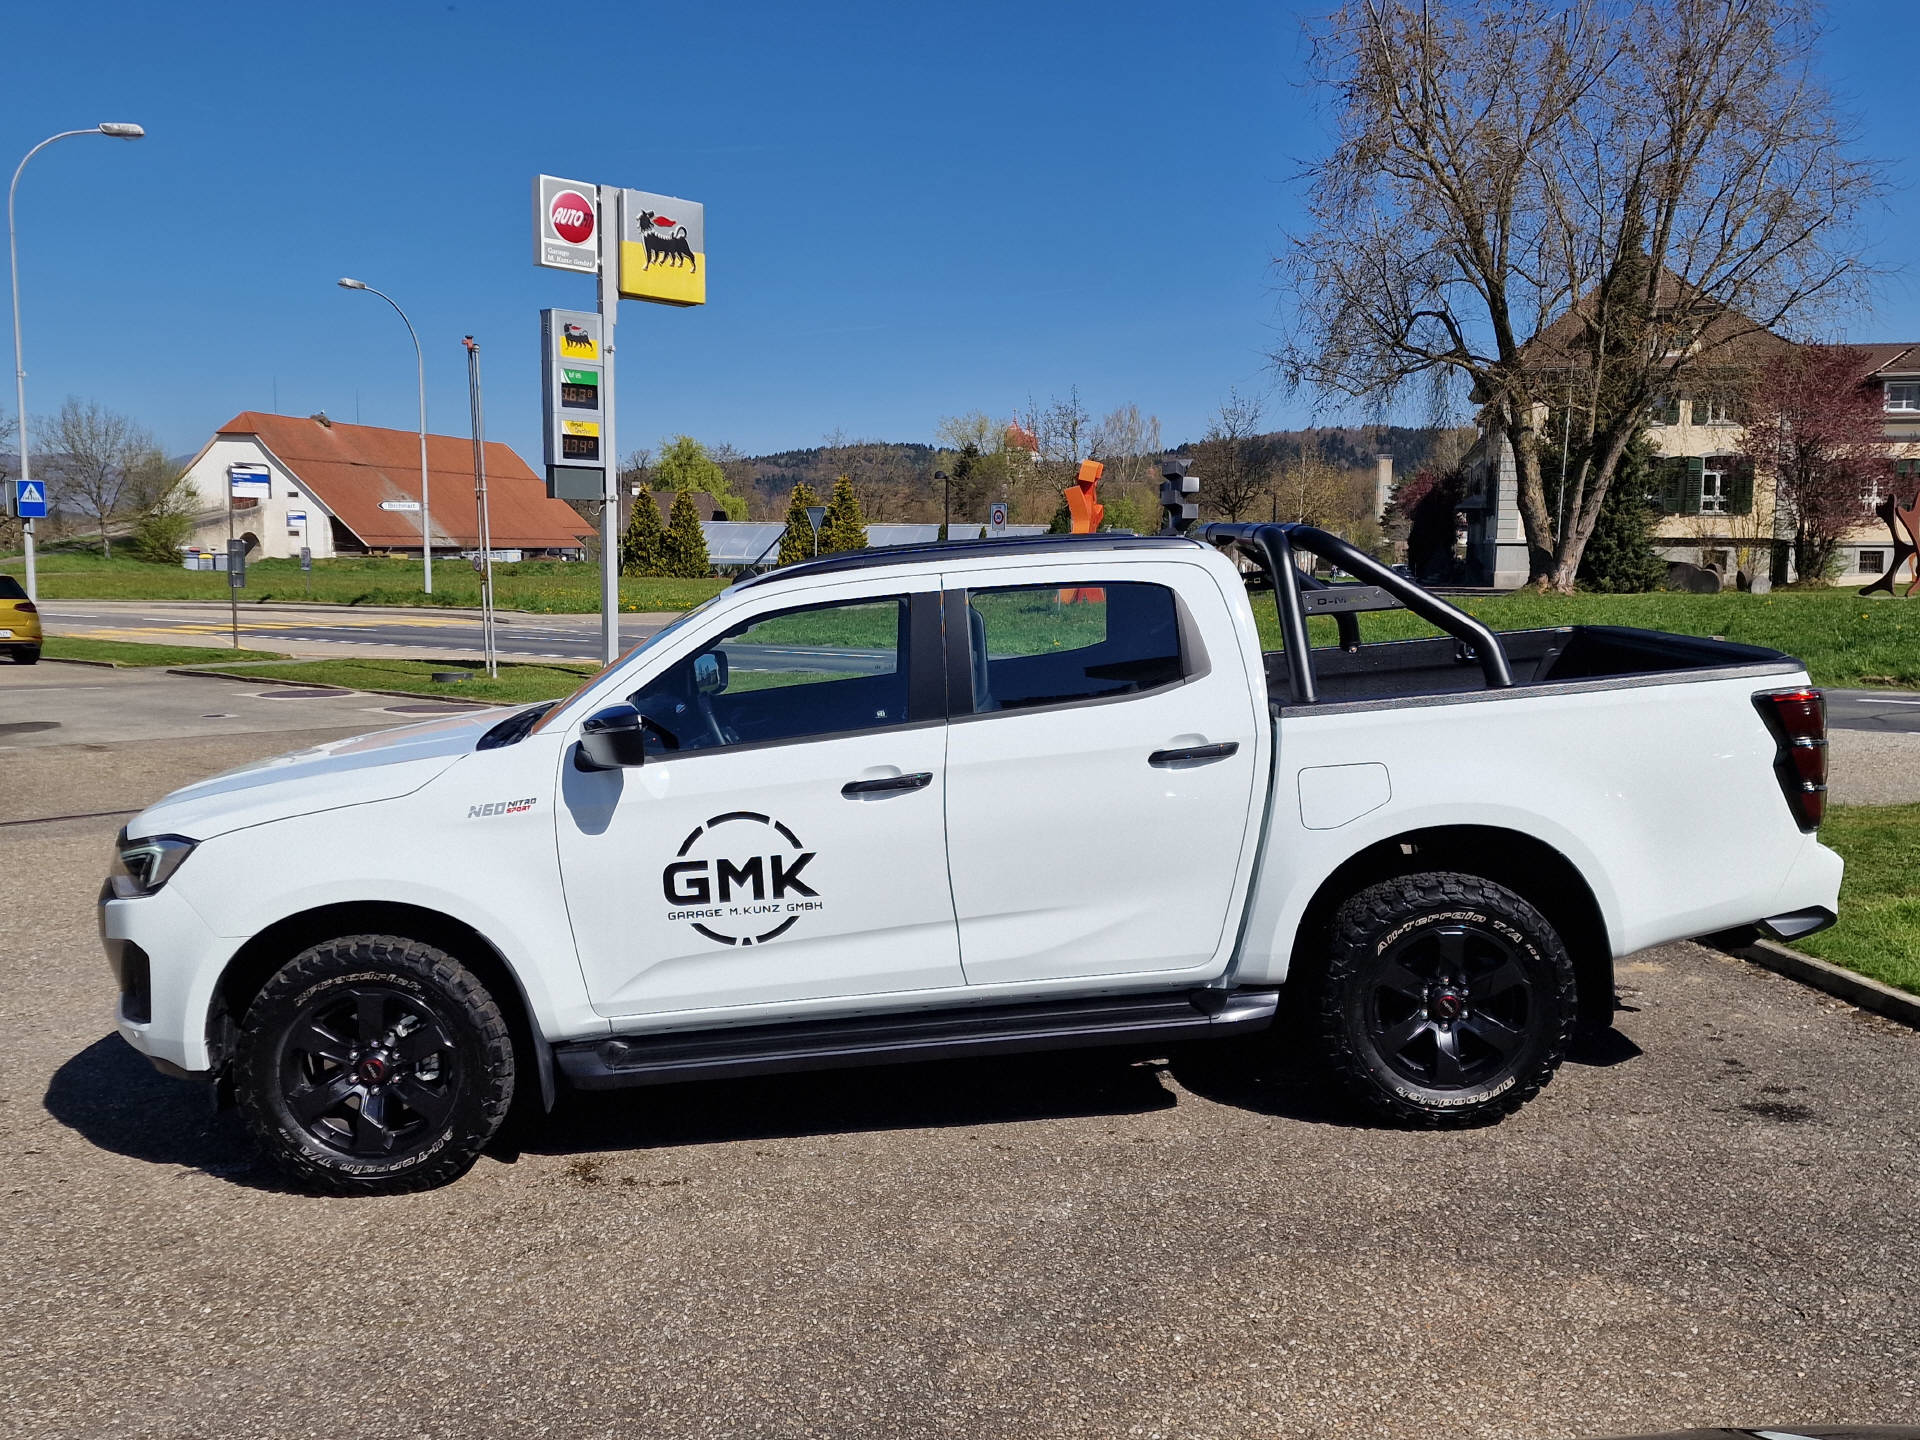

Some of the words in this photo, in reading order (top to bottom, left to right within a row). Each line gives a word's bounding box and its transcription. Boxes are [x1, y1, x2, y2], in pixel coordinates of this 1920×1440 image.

[506, 805, 531, 813] SPORT
[508, 798, 536, 807] NITRO
[663, 852, 821, 906] GMK
[668, 909, 723, 920] GARAGE
[787, 902, 823, 912] GMBH
